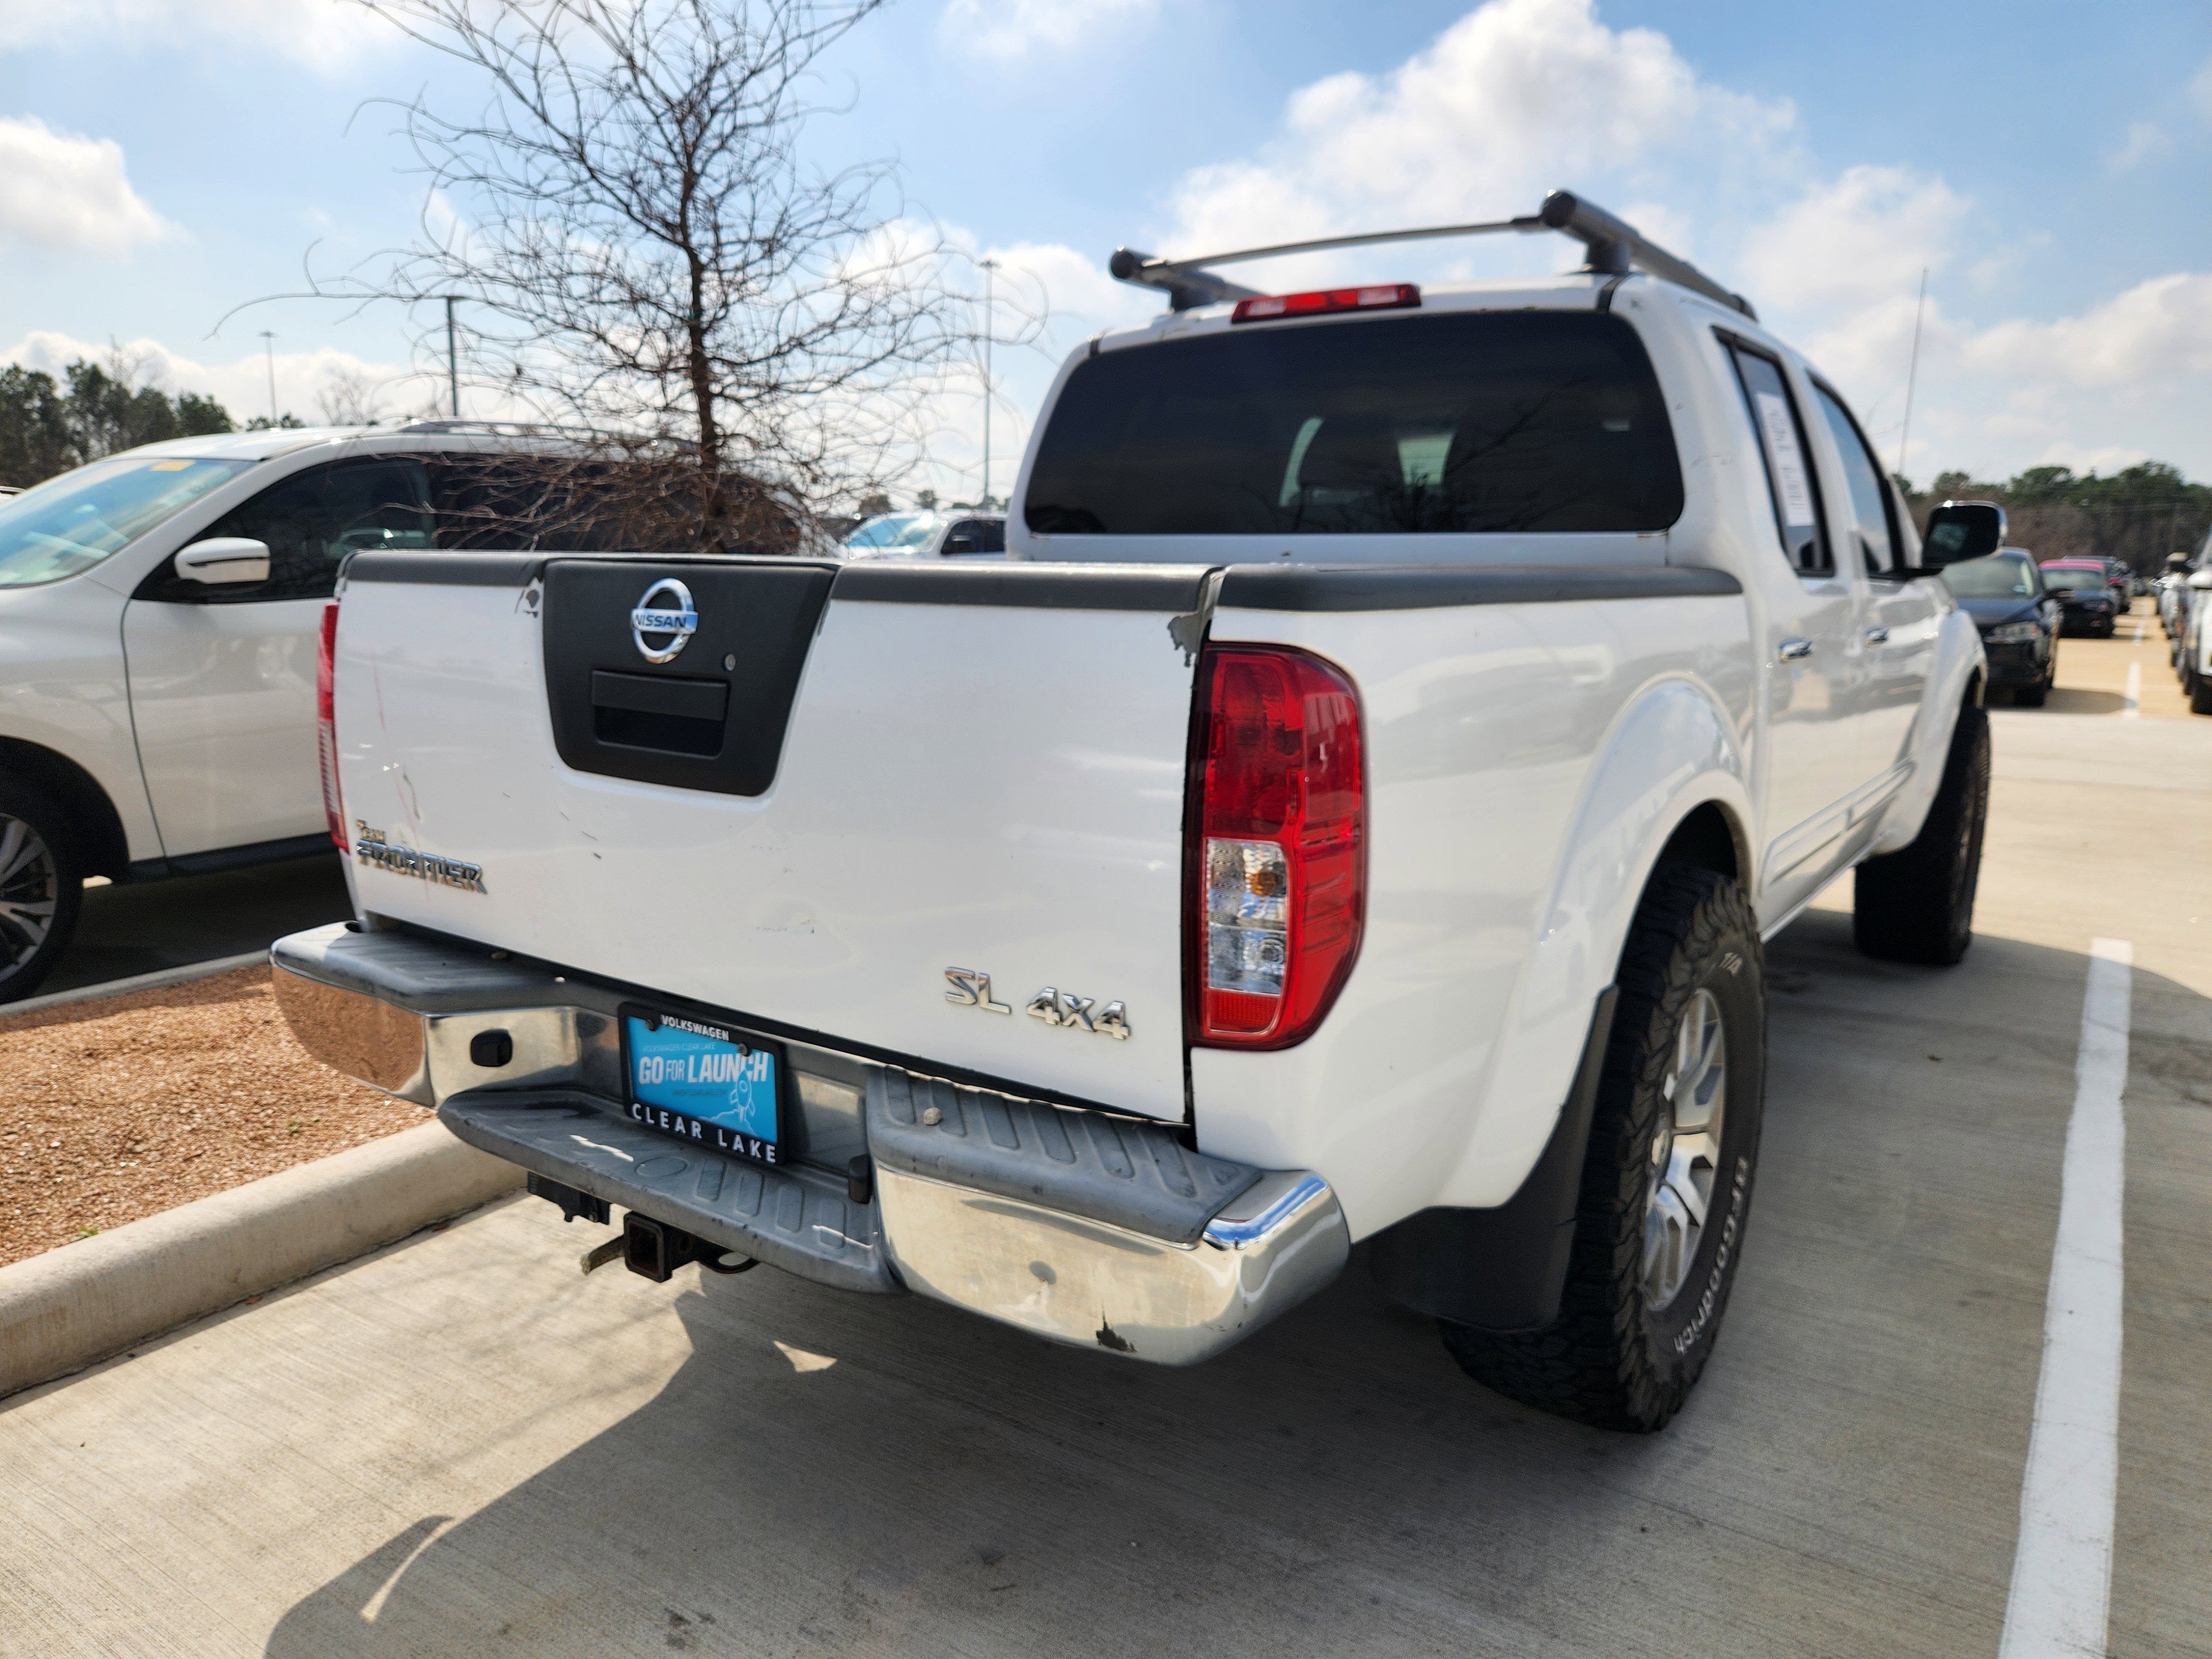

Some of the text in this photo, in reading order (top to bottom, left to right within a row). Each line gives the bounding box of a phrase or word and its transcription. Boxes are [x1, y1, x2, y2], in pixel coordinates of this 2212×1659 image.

[635, 614, 687, 629] NISSAN
[356, 838, 488, 895] FRONTIER
[945, 966, 1012, 1015] SL
[660, 1014, 729, 1041] VOLKSWAGEN
[638, 1052, 769, 1084] GO FOR LAUNCH
[632, 1103, 776, 1163] CLEAR LAKE
